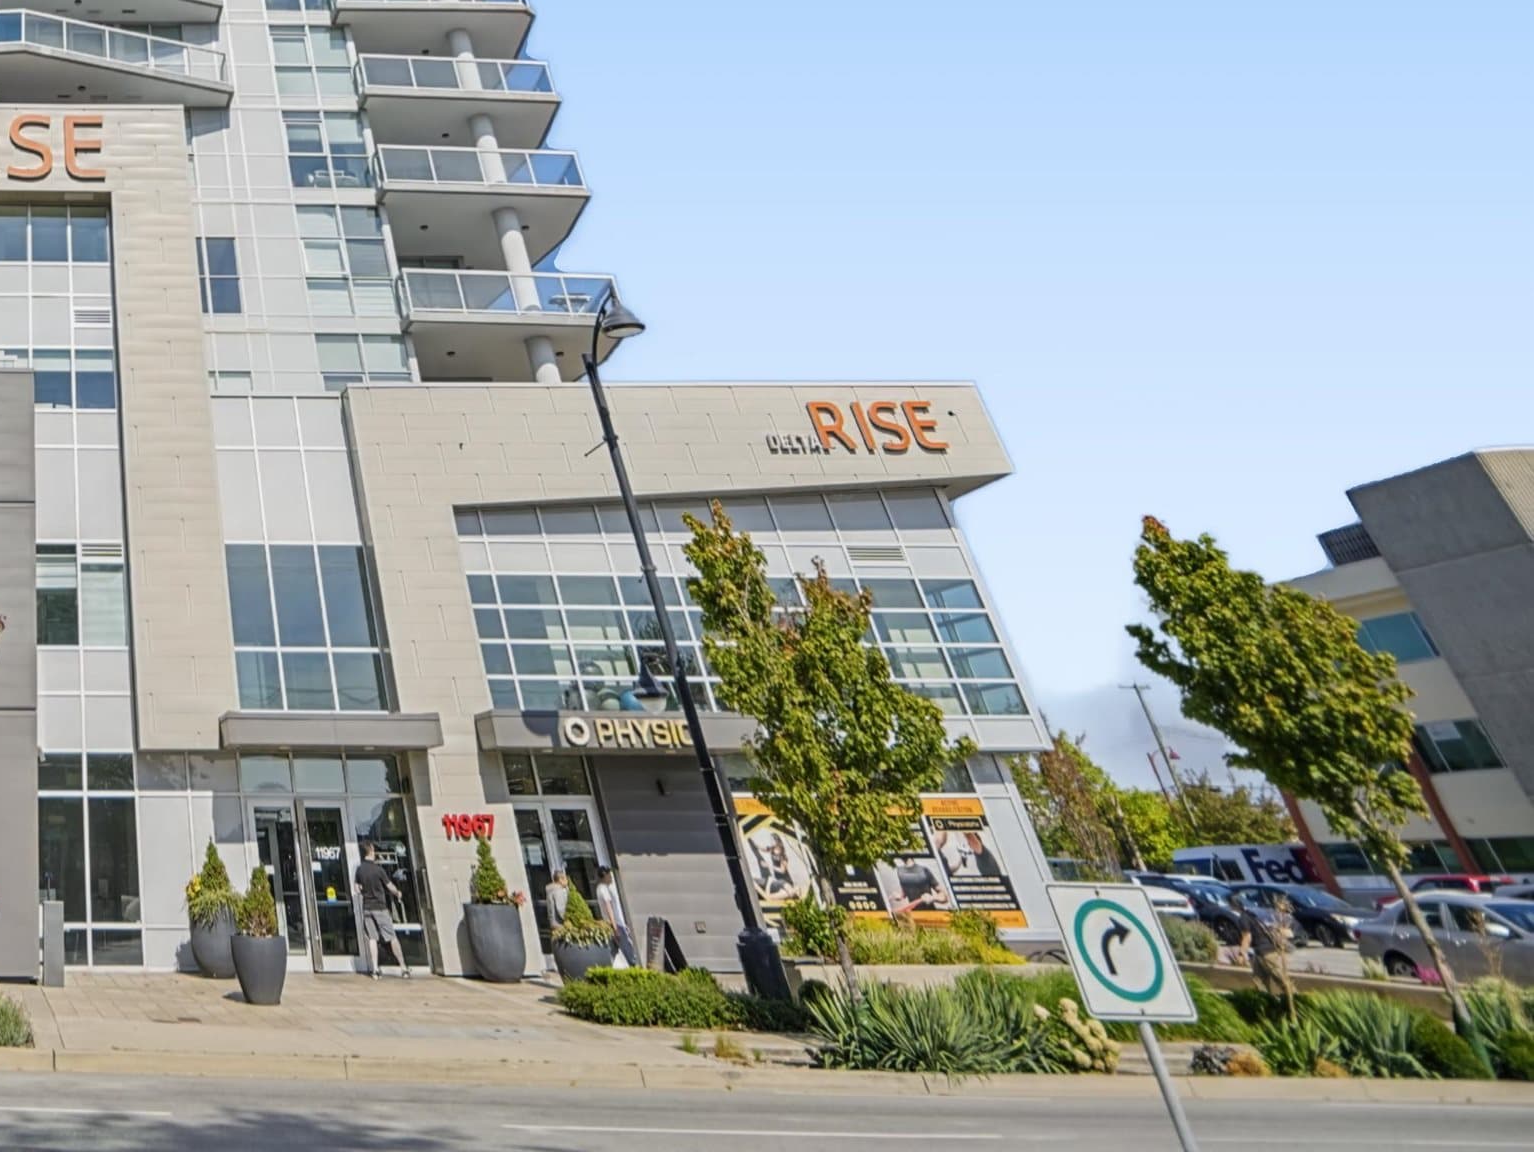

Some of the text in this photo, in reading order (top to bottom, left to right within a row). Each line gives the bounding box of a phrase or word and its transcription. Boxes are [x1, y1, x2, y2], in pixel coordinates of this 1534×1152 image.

[806, 400, 950, 455] RISE
[442, 814, 494, 841] 11967
[316, 847, 340, 860] 11967
